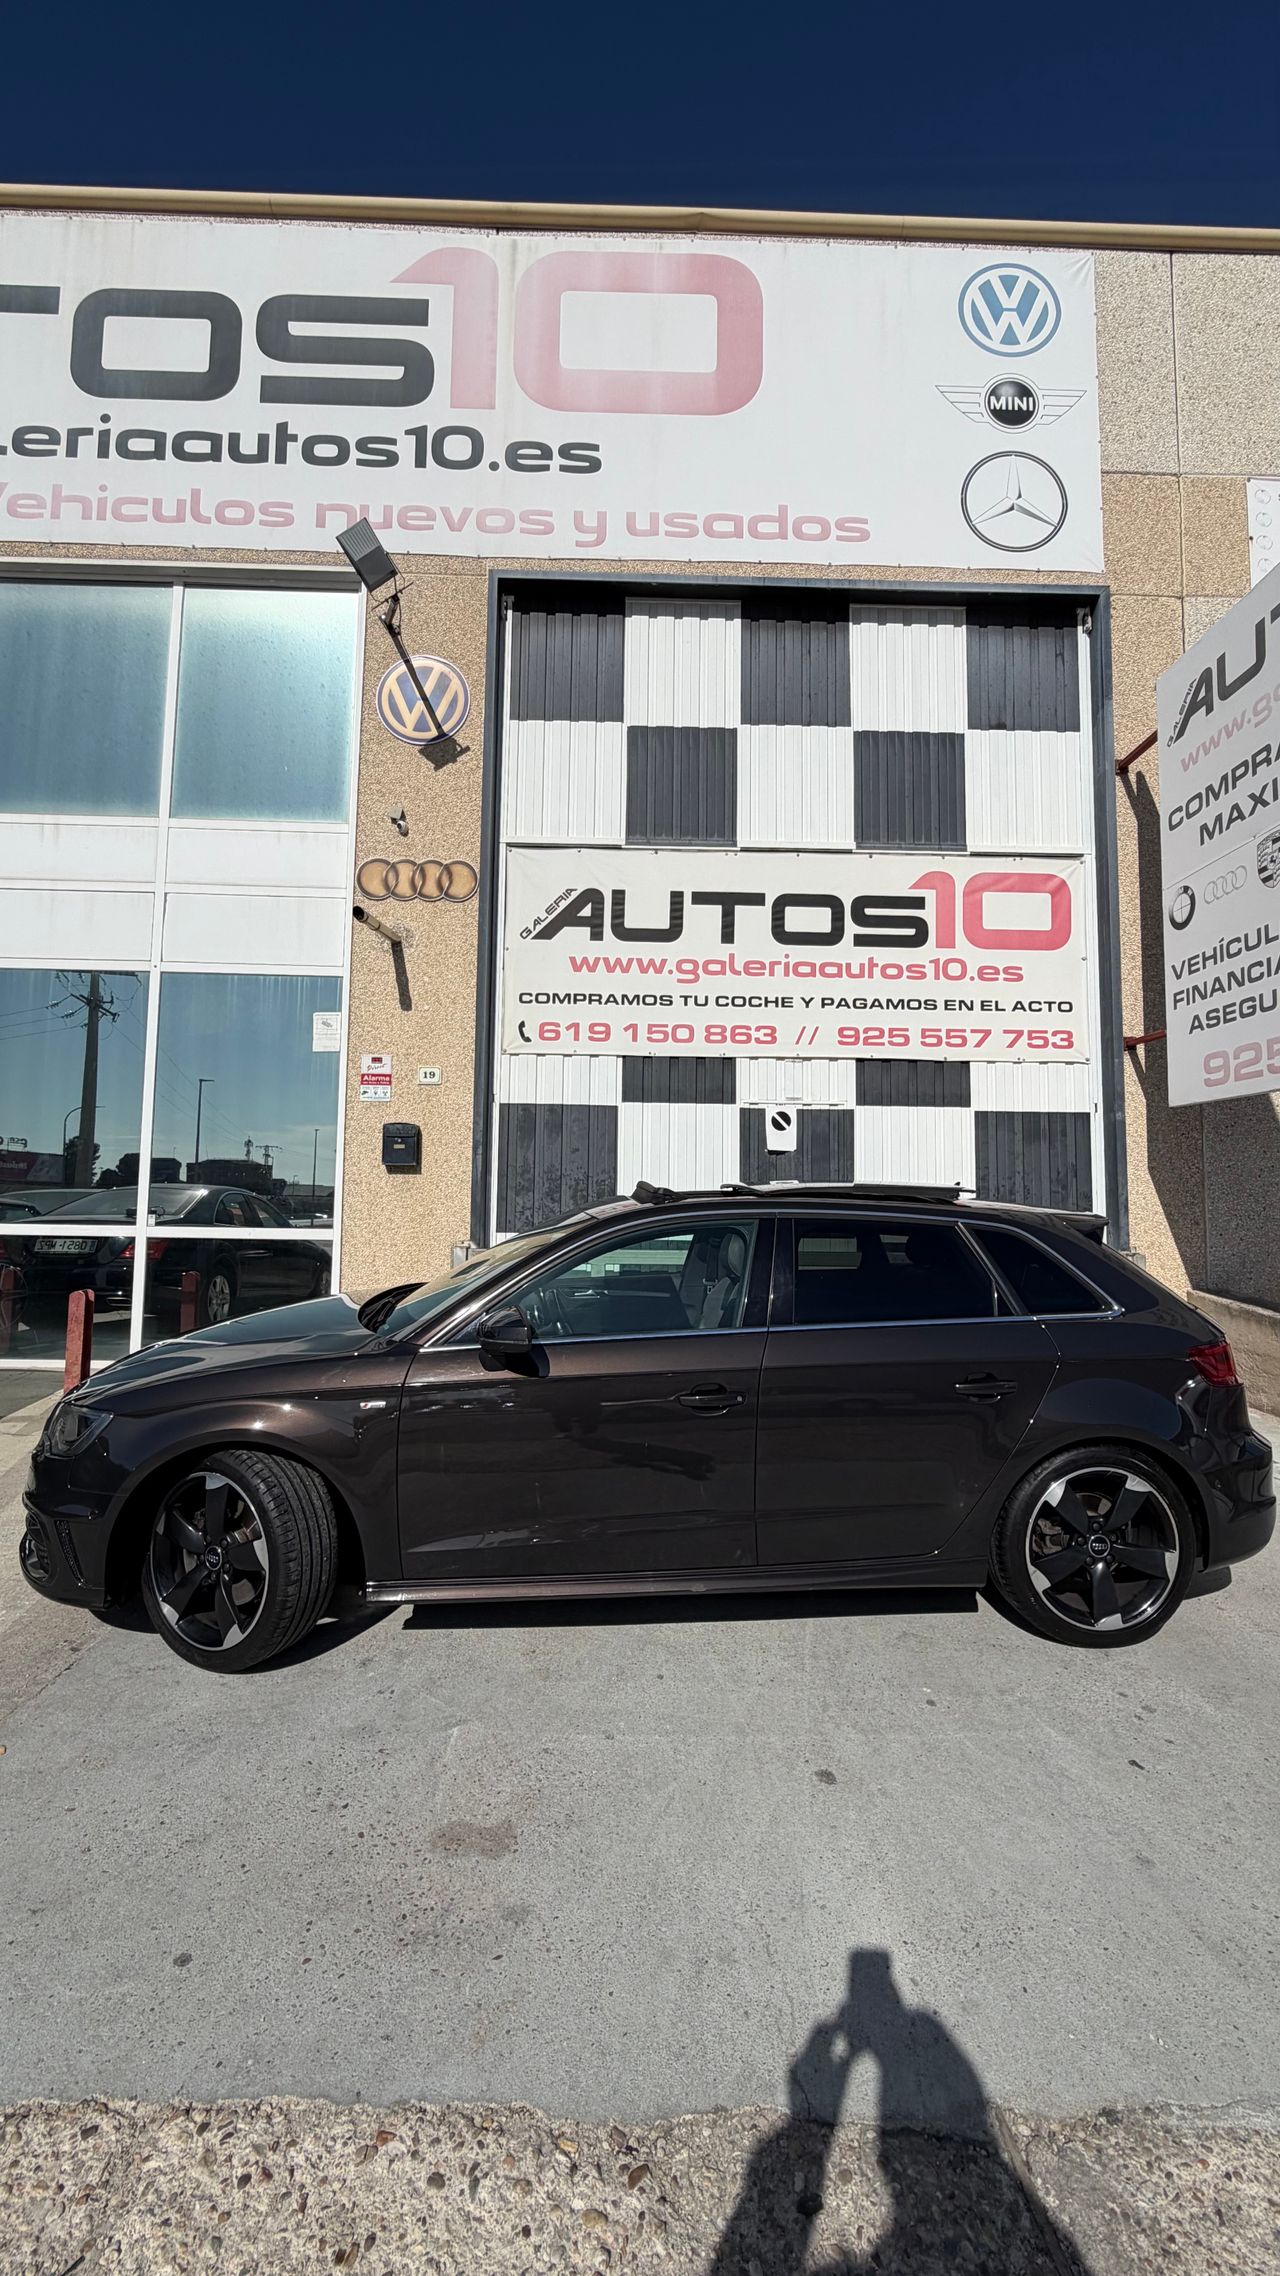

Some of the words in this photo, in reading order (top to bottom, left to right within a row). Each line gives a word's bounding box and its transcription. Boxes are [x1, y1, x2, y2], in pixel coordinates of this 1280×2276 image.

[990, 395, 1033, 412] MINI
[0, 413, 602, 474] eriaautos10.es
[0, 482, 295, 527] ehiculos
[315, 503, 555, 536] nuevos
[573, 510, 608, 548] y
[626, 505, 871, 542] usados
[1173, 602, 1280, 744] AU
[1167, 678, 1197, 748] GALERIA
[519, 888, 578, 940] GALERIA
[530, 871, 1072, 951] AUTOS10
[568, 953, 1025, 983] www.galeriaautos10.es
[518, 992, 674, 1007] COMPRAMOS
[680, 995, 709, 1007] TU
[715, 996, 794, 1009] COCHE
[800, 997, 815, 1009] Y
[821, 997, 938, 1011] PAGAMOS
[944, 999, 974, 1011] EN
[980, 1000, 1006, 1012] EL
[1012, 1001, 1074, 1013] ACTO
[538, 1021, 611, 1042] 619
[623, 1023, 695, 1043] 150
[704, 1024, 777, 1045] 863
[837, 1026, 911, 1047] 925
[920, 1028, 992, 1048] 557
[1003, 1029, 1075, 1050] 753
[363, 1074, 390, 1082] Alarma
[423, 1071, 435, 1079] 19
